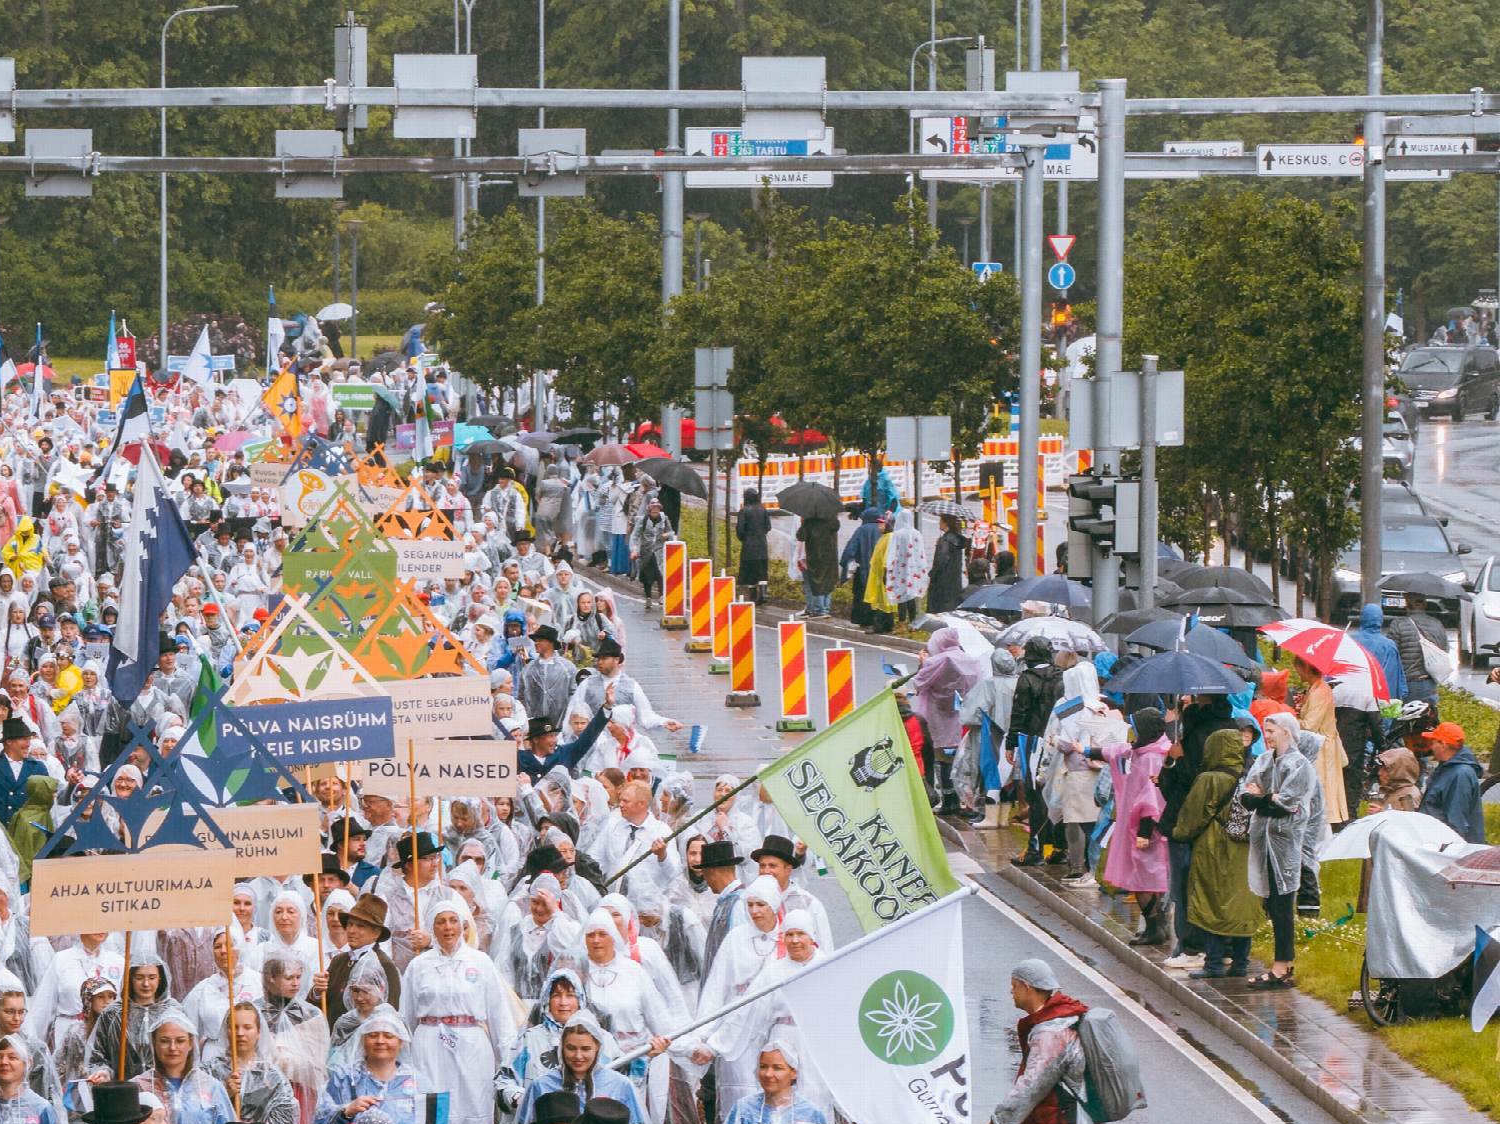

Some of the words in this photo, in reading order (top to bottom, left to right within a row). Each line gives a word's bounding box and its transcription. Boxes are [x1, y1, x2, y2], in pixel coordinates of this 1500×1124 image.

[755, 146, 788, 156] TARTU
[1278, 154, 1332, 166] KESKUS,
[1339, 154, 1347, 165] C
[755, 173, 809, 183] LSNAMÄE
[288, 710, 387, 733] NAISRÜHM
[301, 735, 362, 756] KIRSID
[438, 763, 511, 780] NAISED
[784, 760, 913, 927] SEGAKOO
[50, 884, 91, 899] AHJA
[95, 876, 214, 896] KULTUURIMAJA
[100, 897, 162, 913] SITIKAD
